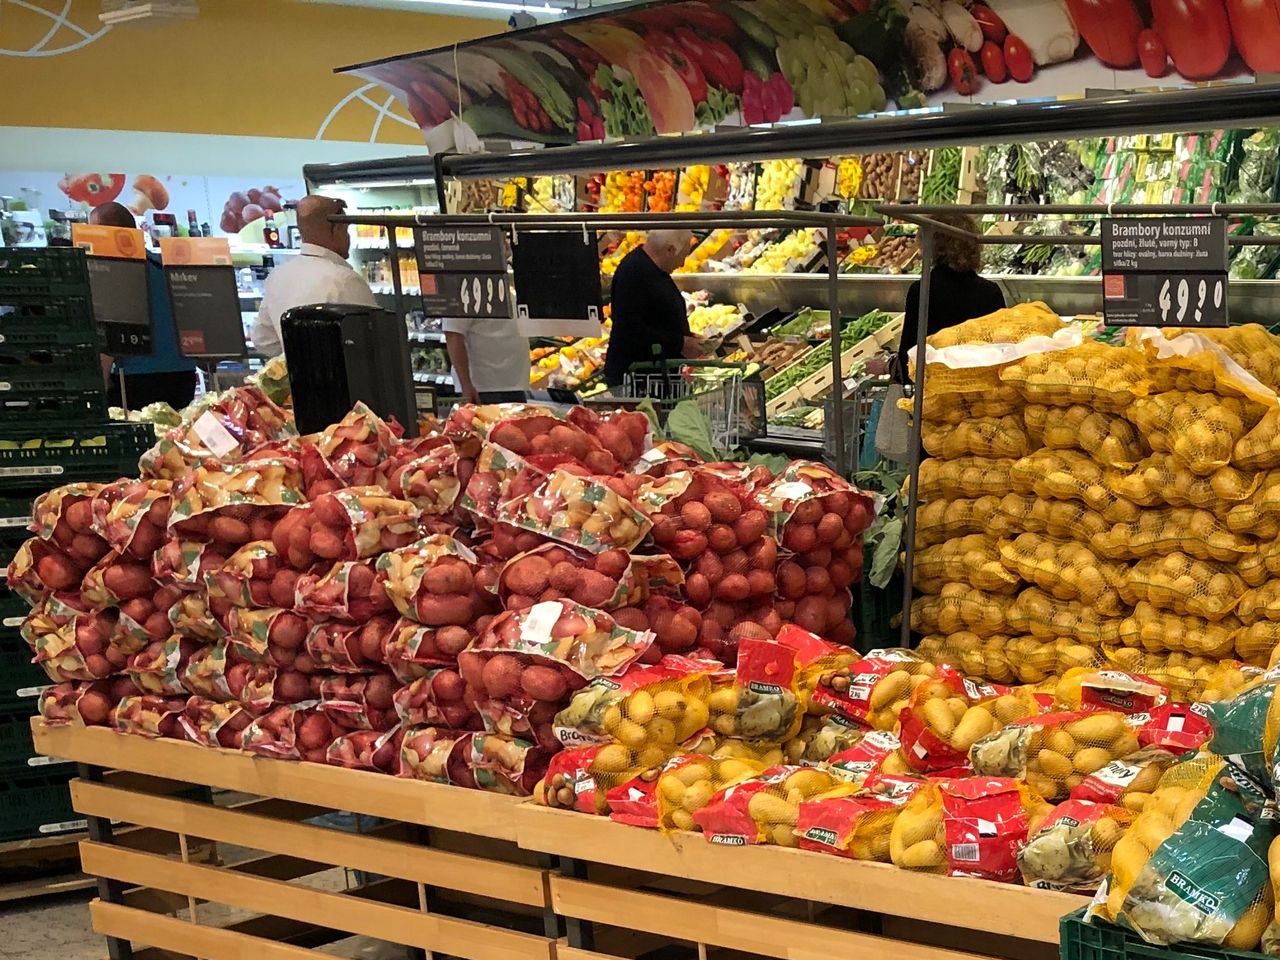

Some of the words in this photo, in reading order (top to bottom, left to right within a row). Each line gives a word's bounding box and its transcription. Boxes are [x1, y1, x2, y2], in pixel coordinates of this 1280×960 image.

[1112, 223, 1161, 239] Brambory
[1163, 222, 1211, 236] konzumní
[422, 230, 456, 244] Brambory
[1112, 238, 1138, 249] pozdní,
[1139, 238, 1157, 249] žluté,
[1158, 238, 1178, 249] varný
[1179, 239, 1193, 249] typ:
[752, 683, 780, 693] BRAMKO
[711, 835, 744, 846] BRAMKO
[1171, 873, 1216, 908] BRAMKO
